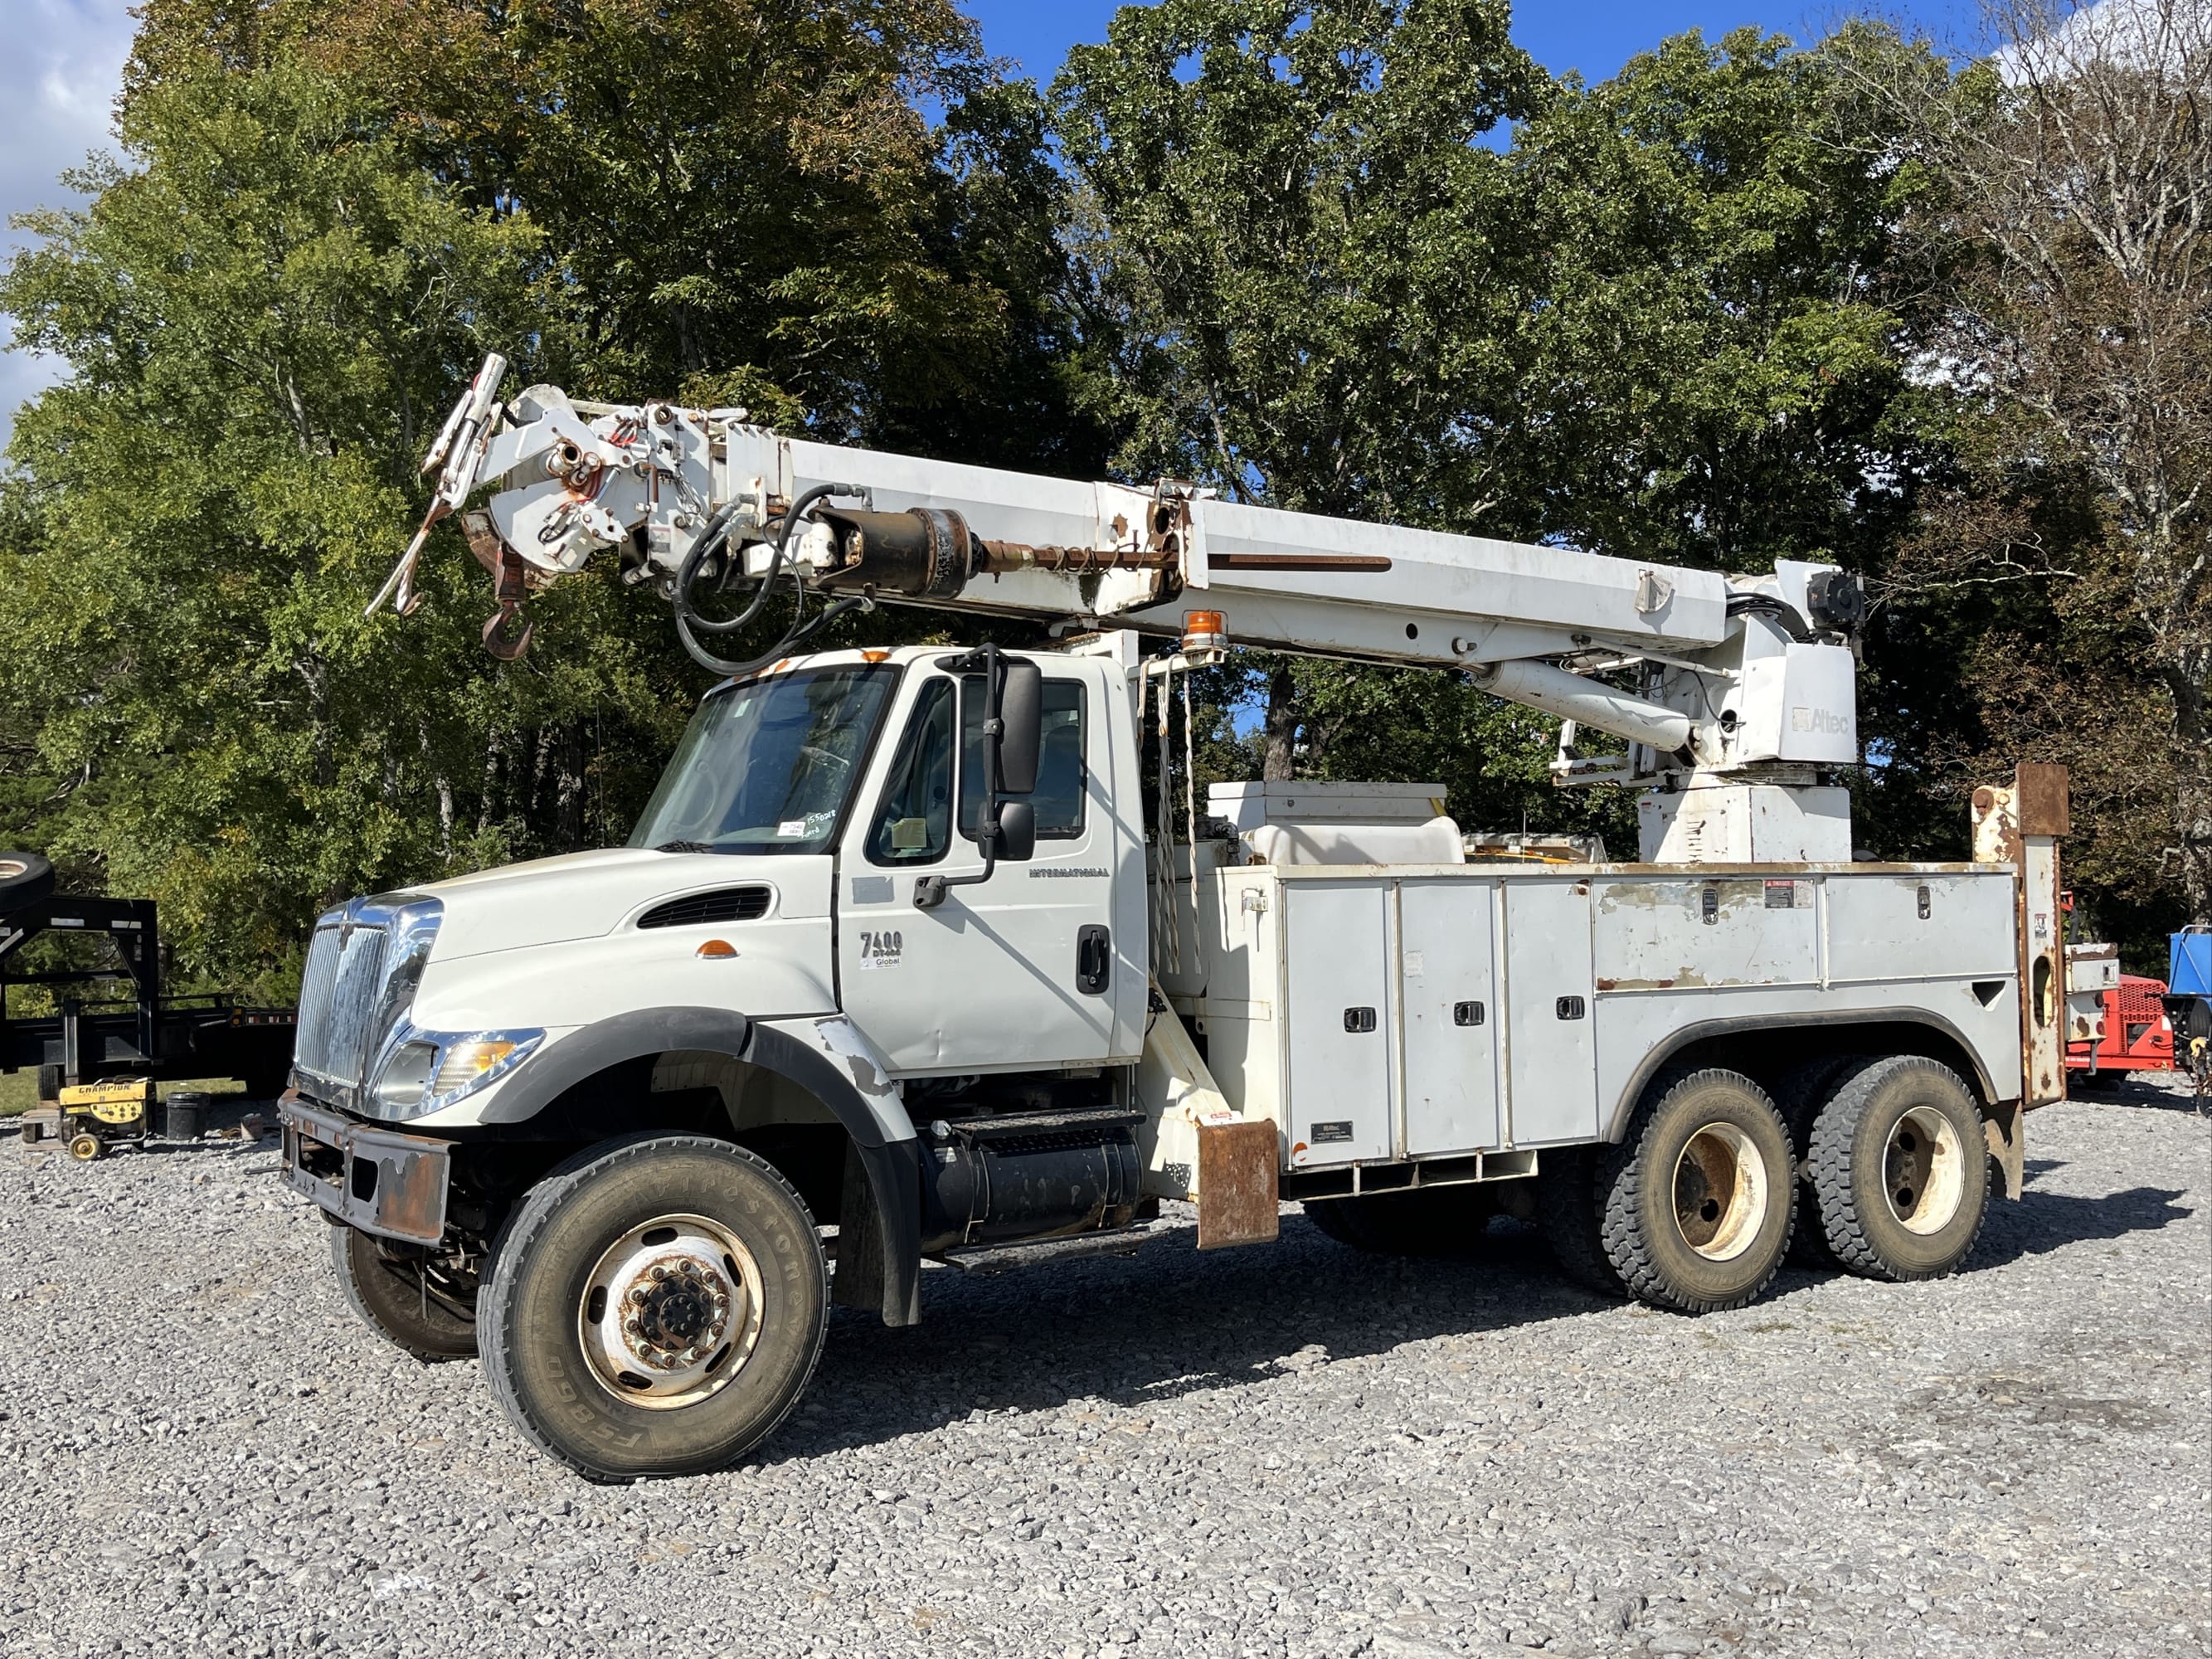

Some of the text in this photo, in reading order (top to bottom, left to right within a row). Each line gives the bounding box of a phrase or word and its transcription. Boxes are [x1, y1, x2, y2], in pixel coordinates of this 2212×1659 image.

[1028, 868, 1110, 878] INTERNATIONAL
[860, 931, 902, 958] 7400
[79, 1085, 130, 1094] CHAMPION
